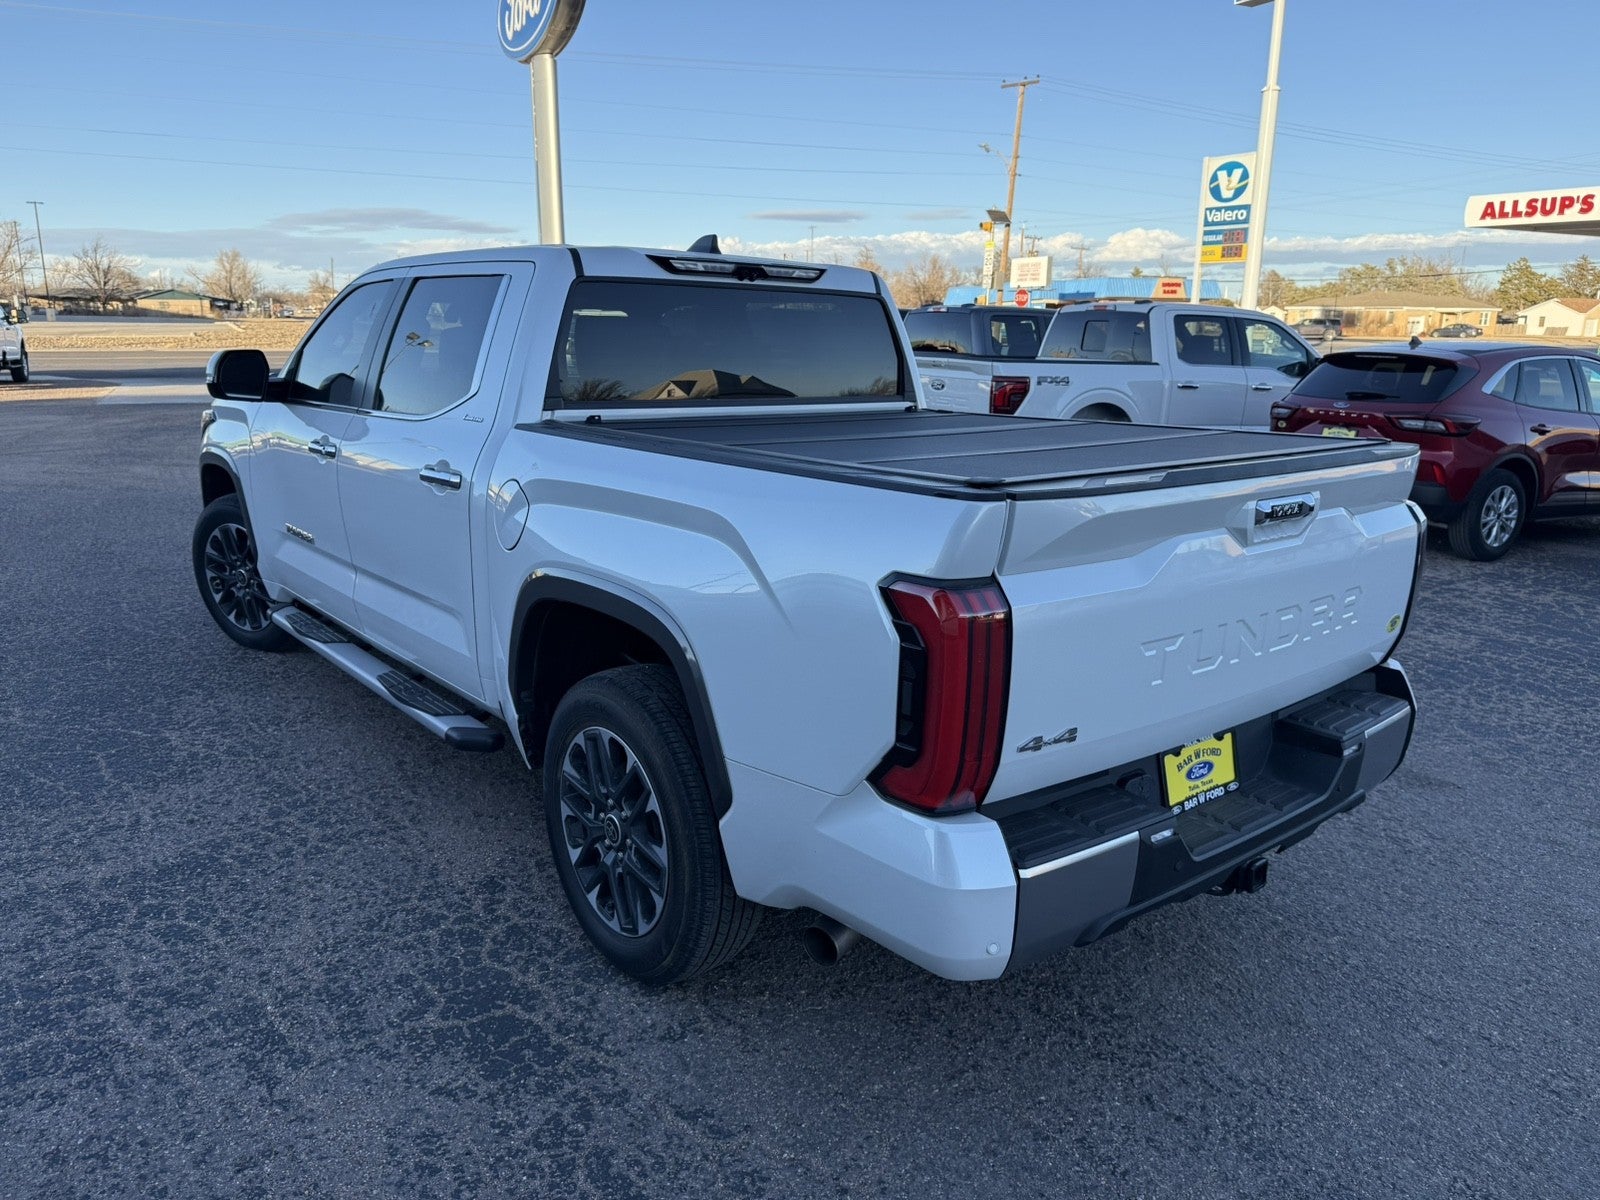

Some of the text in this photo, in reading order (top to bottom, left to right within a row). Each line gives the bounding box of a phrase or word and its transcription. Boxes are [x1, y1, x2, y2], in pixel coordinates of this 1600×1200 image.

[1206, 209, 1247, 222] Valero
[1479, 194, 1596, 220] ALLSUP'S
[1015, 294, 1028, 302] STOP
[1141, 585, 1363, 686] TUNDRA
[1176, 747, 1222, 773] BAR W FORD
[1190, 763, 1209, 779] Ford
[1184, 797, 1198, 811] BAR
[1198, 792, 1205, 804] W
[1206, 786, 1225, 801] FORD
